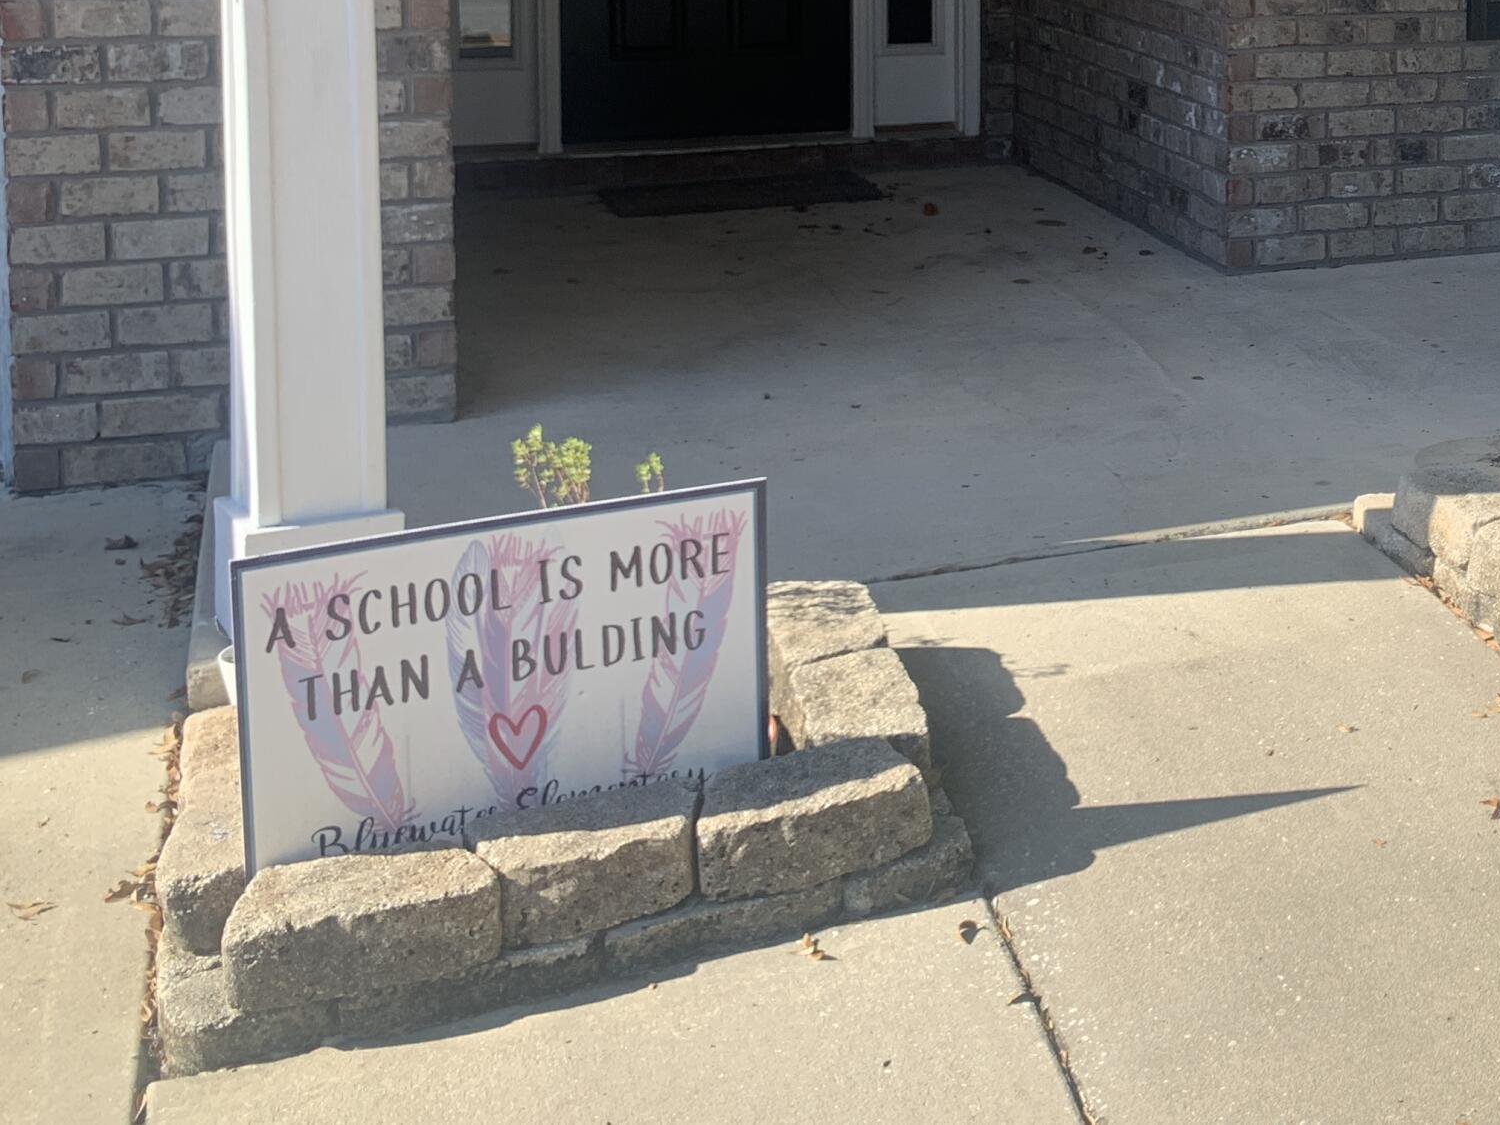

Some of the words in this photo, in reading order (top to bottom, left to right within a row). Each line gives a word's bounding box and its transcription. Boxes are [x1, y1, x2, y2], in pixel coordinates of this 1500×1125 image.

[265, 607, 295, 653] A
[325, 567, 512, 642] SCHOOL
[538, 554, 584, 605] IS
[609, 532, 731, 592] MORE
[298, 654, 430, 721] THAN
[456, 649, 485, 692] A
[512, 610, 707, 682] BULDING
